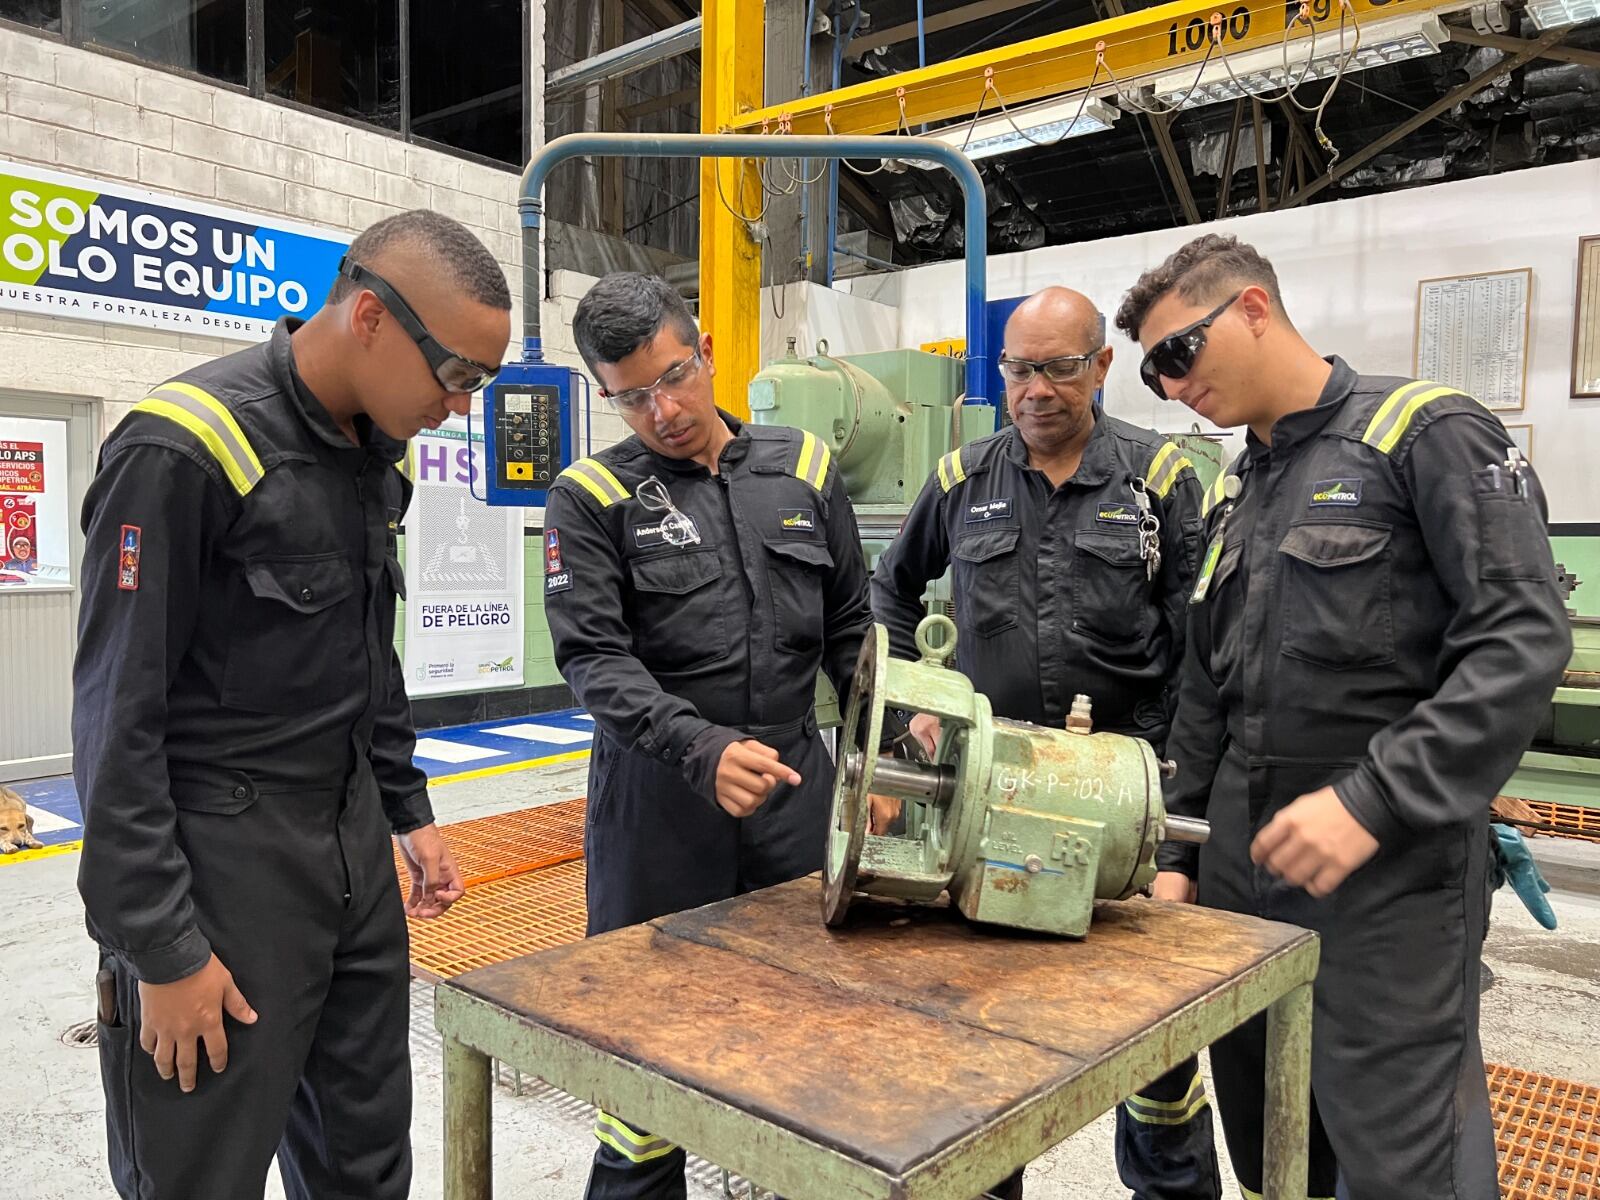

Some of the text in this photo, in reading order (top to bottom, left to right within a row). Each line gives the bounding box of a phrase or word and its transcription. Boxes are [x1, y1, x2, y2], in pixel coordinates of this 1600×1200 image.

[1167, 6, 1250, 56] 1.000
[8, 189, 275, 272] SOMOS UN
[3, 233, 309, 313] OLO EQUIPO
[93, 301, 192, 322] FORTALEZA
[203, 317, 251, 331] DESDE
[14, 451, 36, 461] APS
[420, 444, 479, 484] HS
[970, 505, 988, 513] Omar
[547, 573, 569, 588] 2022
[422, 601, 509, 614] FUERA DE LA LÍNEA
[422, 612, 511, 628] DE PELIGRO
